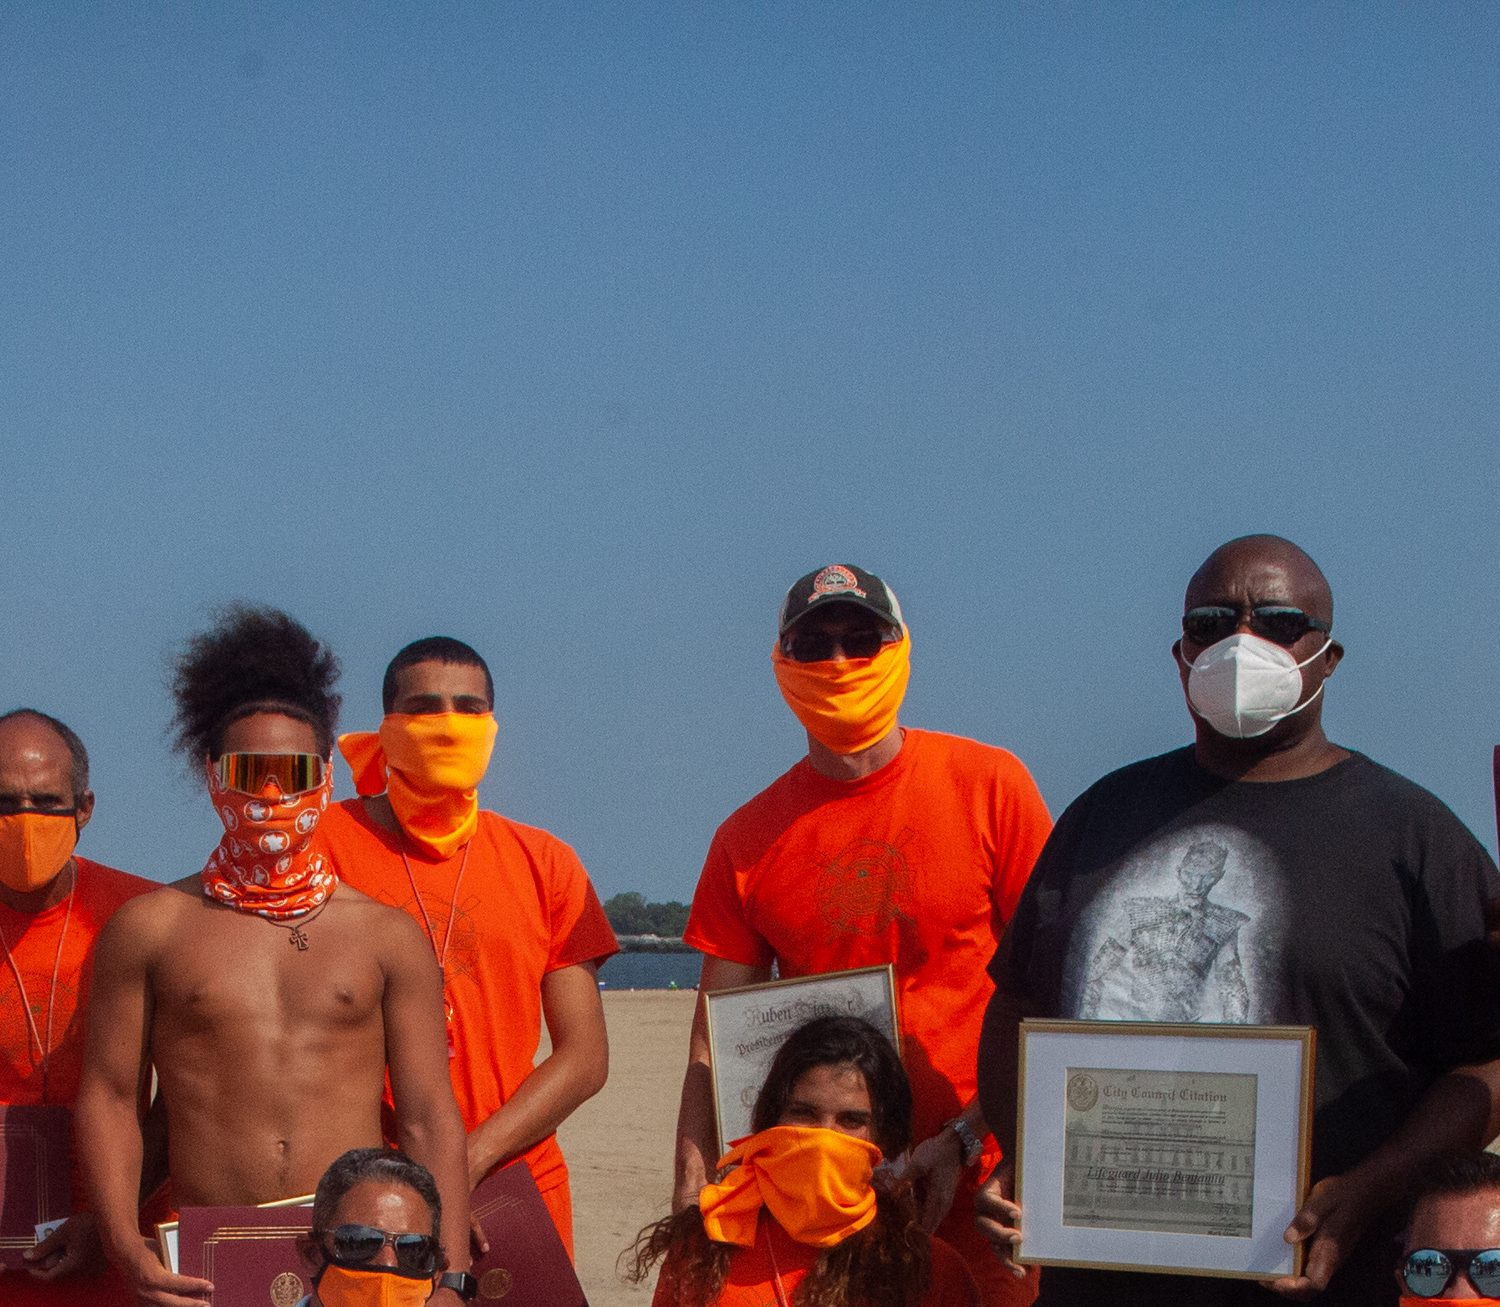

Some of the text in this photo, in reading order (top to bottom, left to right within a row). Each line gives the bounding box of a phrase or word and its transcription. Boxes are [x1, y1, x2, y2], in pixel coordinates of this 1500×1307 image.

[735, 1031, 786, 1058] Presiden
[1102, 1085, 1227, 1102] City Council Citation
[1087, 1166, 1142, 1180] Lifeguard
